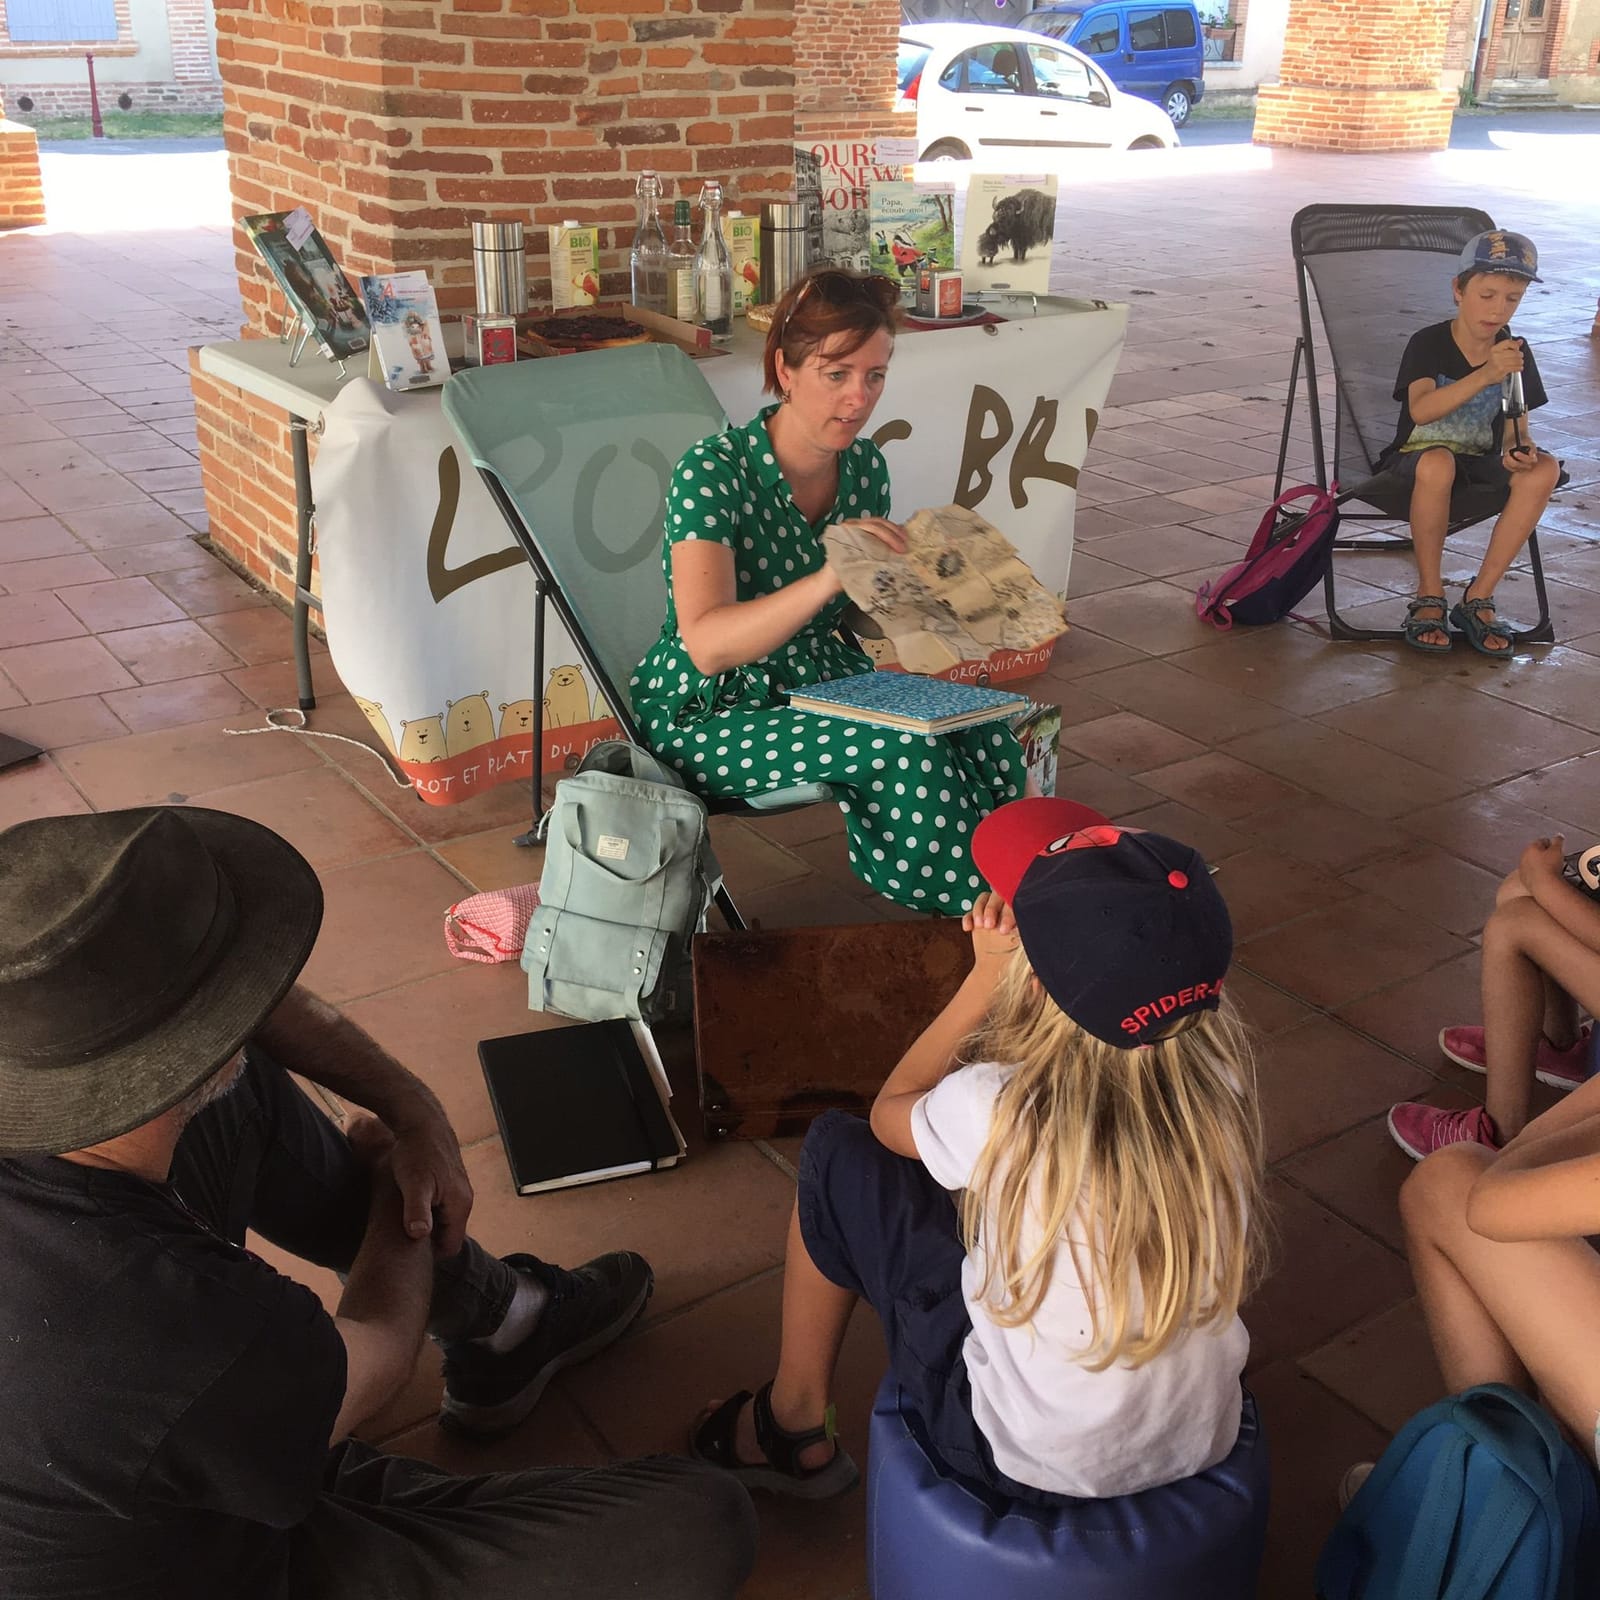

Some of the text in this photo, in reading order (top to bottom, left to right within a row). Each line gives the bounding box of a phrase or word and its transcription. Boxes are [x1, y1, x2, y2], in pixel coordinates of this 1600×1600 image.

[811, 144, 884, 167] OURS
[839, 167, 899, 187] NEW
[817, 187, 868, 211] YOR
[570, 236, 591, 248] BIO
[733, 226, 752, 237] BIO
[953, 384, 1098, 511] BR
[949, 646, 1054, 681] ORGANISATION
[463, 764, 481, 785] ET
[488, 749, 534, 775] PLAT
[551, 742, 572, 759] DU
